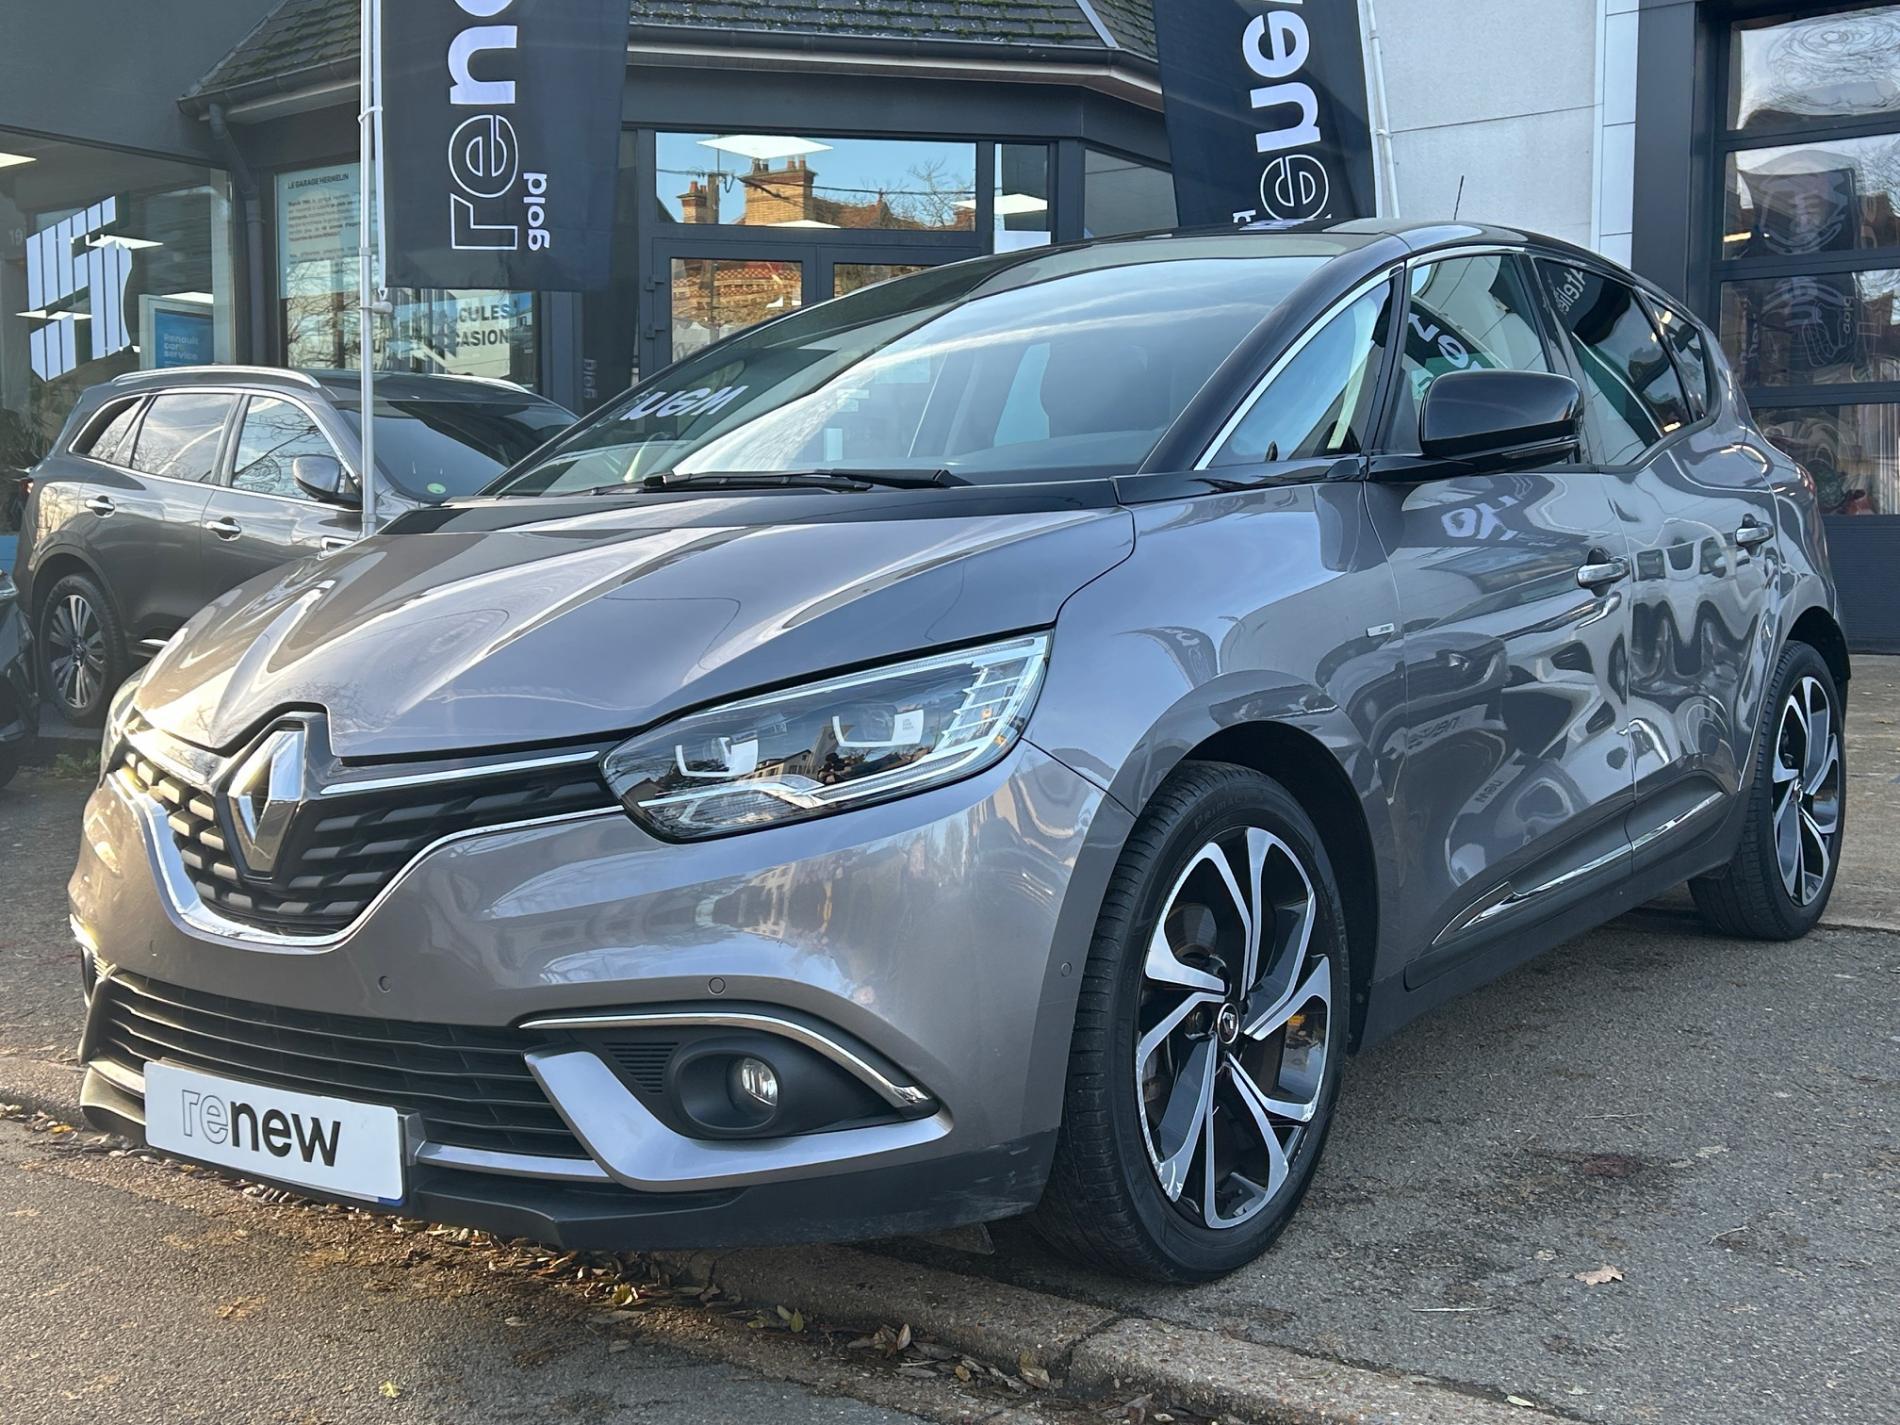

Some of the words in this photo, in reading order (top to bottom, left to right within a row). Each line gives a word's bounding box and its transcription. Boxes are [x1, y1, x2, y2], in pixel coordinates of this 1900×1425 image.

[447, 0, 519, 251] ren
[523, 172, 550, 251] gold
[181, 1089, 342, 1167] renew
